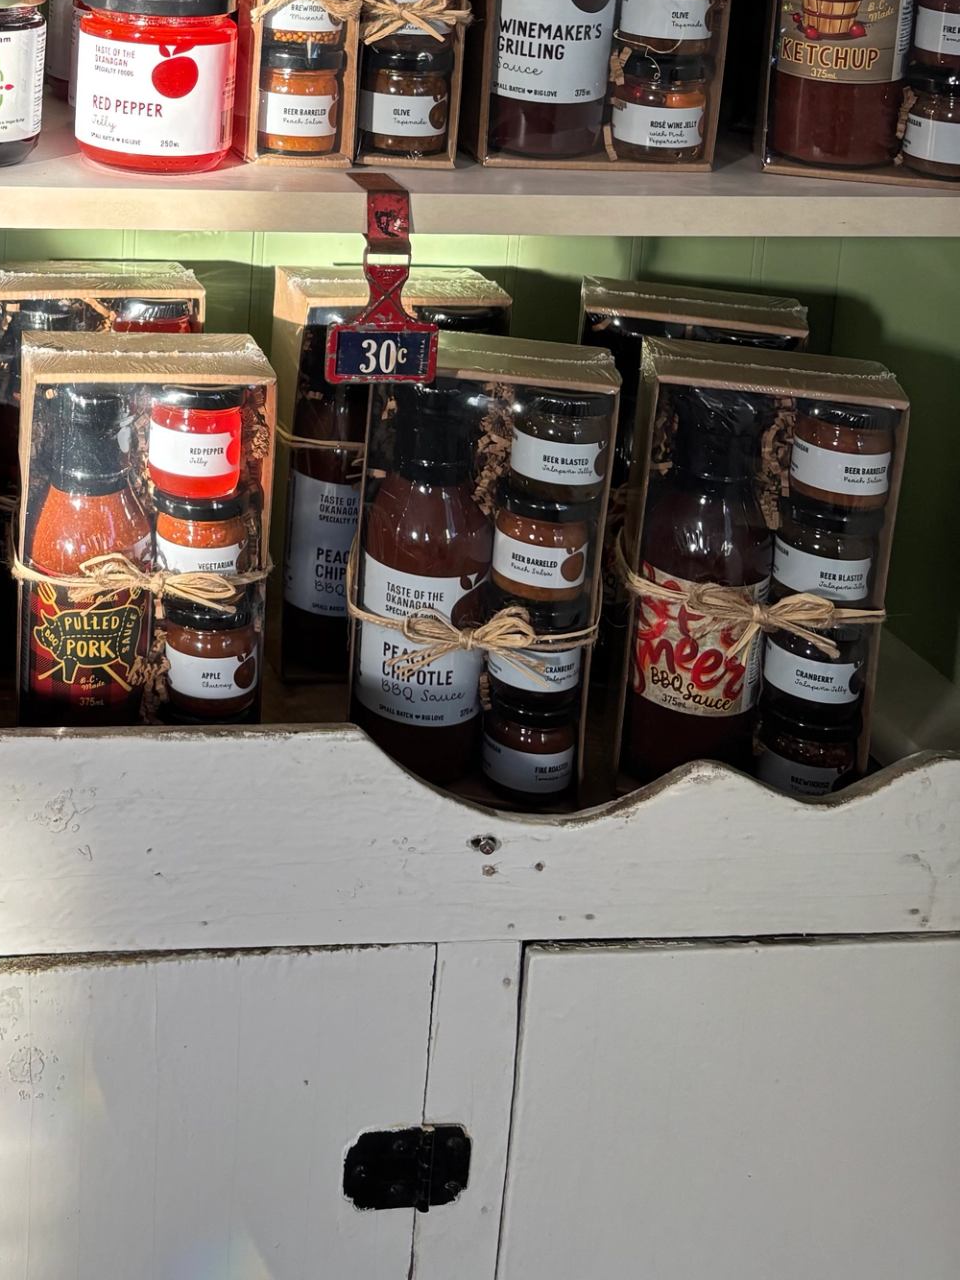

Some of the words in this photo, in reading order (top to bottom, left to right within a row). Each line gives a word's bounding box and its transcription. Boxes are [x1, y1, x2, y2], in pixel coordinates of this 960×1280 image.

[500, 18, 602, 41] WINEMAKER'S
[497, 35, 565, 60] GRILLING
[781, 37, 880, 70] KETCHUP
[496, 56, 544, 76] Sauce
[92, 94, 112, 110] RED
[115, 98, 163, 118] PEPPER
[393, 108, 411, 117] OLIVE
[667, 121, 683, 129] WINE
[190, 447, 201, 455] RED
[203, 447, 224, 455] PEPPER
[542, 454, 560, 465] BEER
[560, 457, 589, 466] BLASTED
[198, 560, 233, 570] VEGETARIAN
[386, 582, 411, 598] TASTE
[414, 590, 425, 599] OF
[428, 592, 444, 601] THE
[386, 592, 435, 610] OKANAGAN
[64, 615, 120, 631] PULLED
[44, 628, 59, 648] BBQ
[121, 612, 137, 654] SAUCE
[66, 639, 116, 658] PORK
[201, 671, 221, 680] APPLE
[795, 669, 834, 684] CRANBERRY
[381, 678, 414, 703] BBQ
[420, 689, 466, 703] Sauce
[651, 666, 683, 693] BBQ
[682, 682, 732, 711] Sauce
